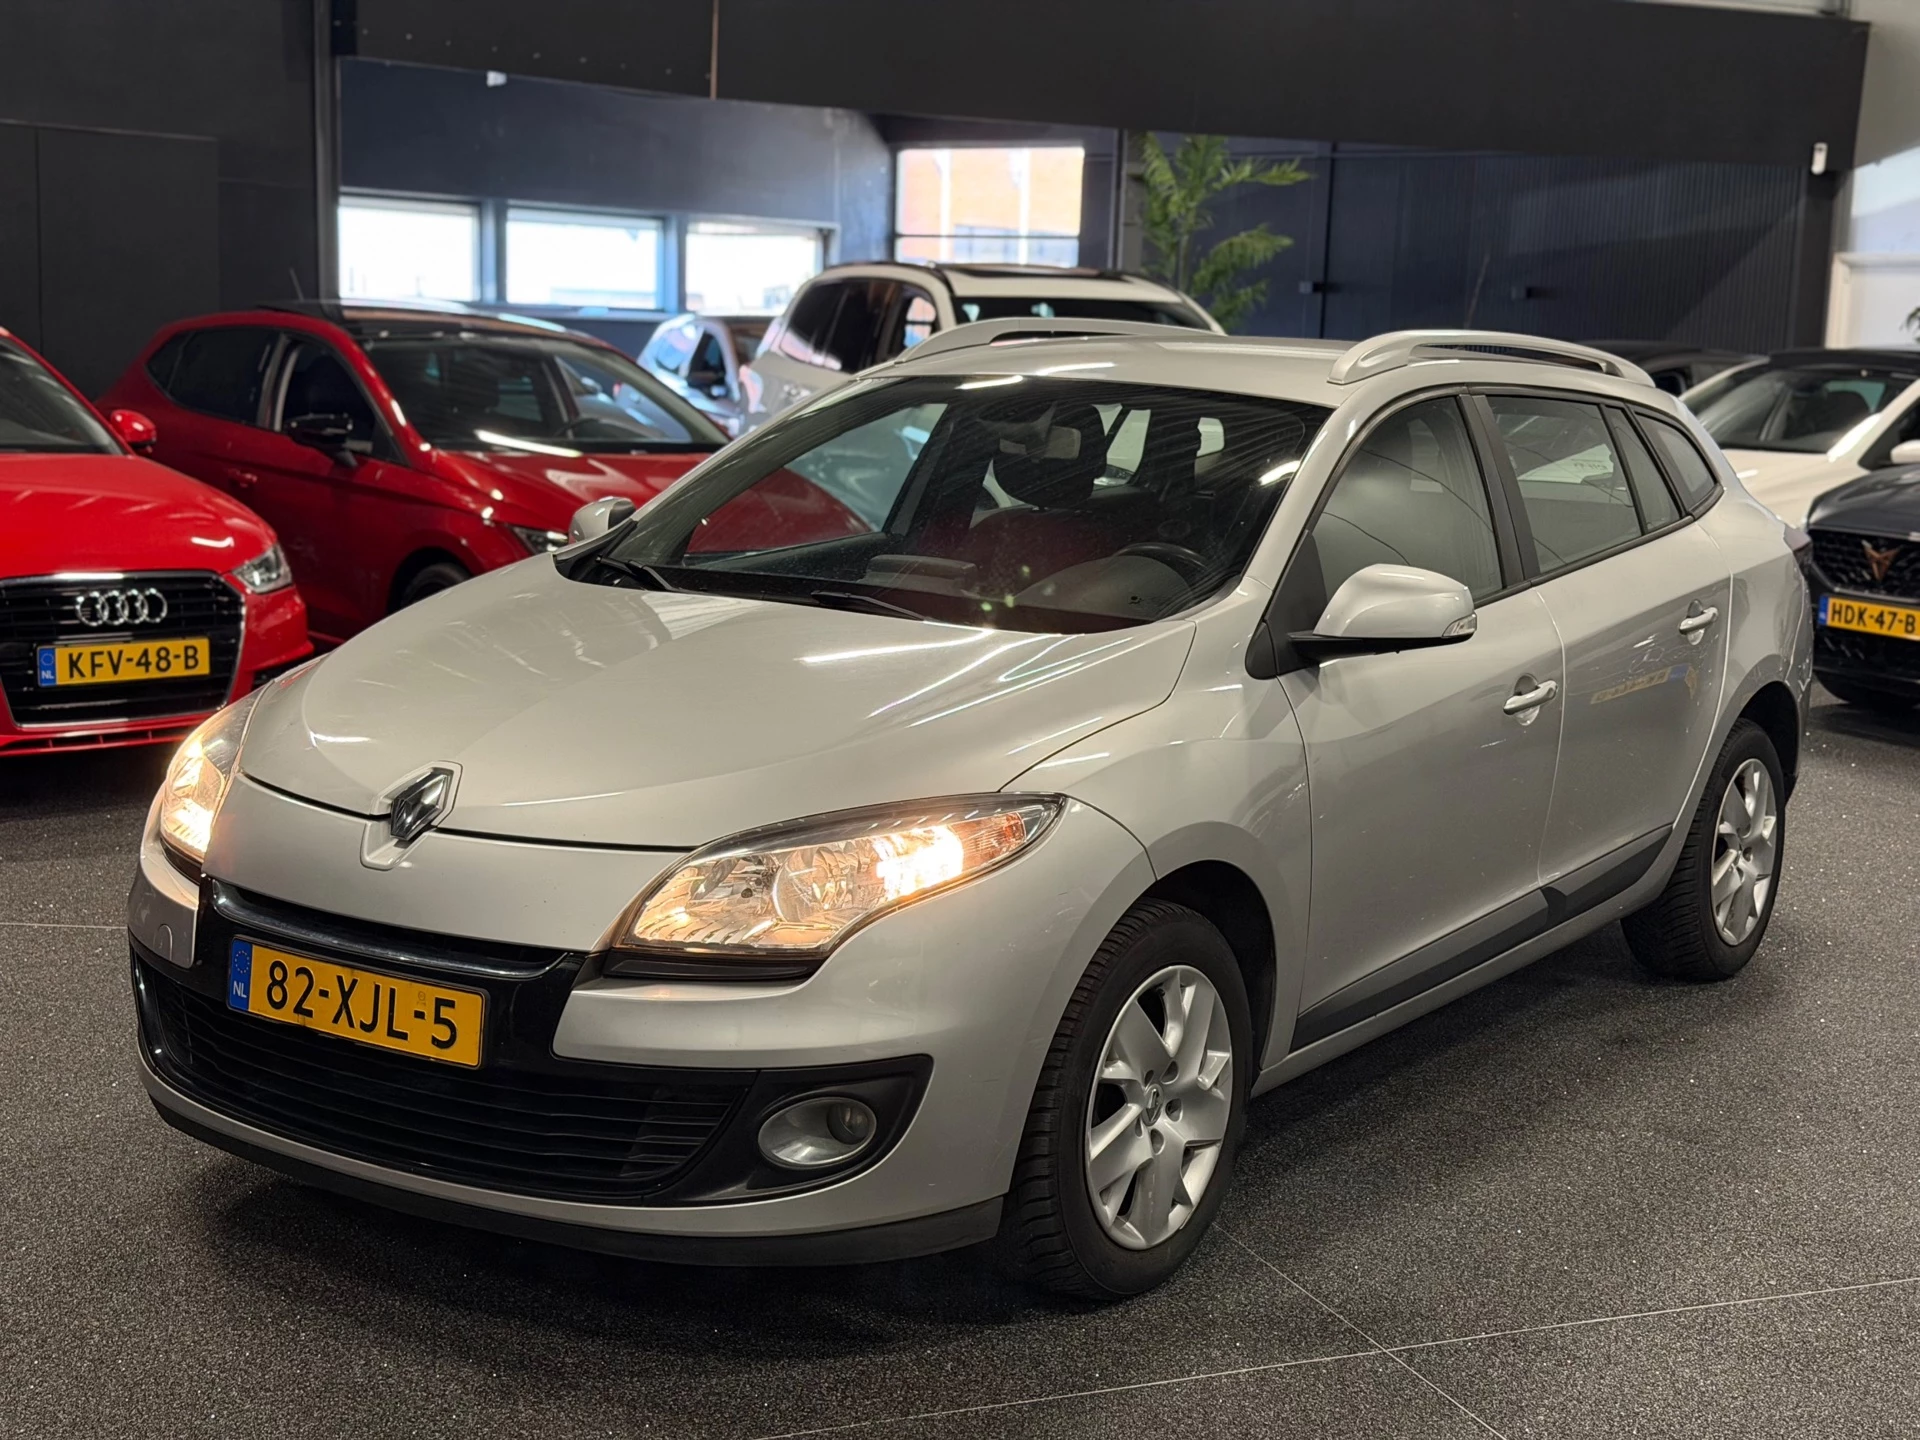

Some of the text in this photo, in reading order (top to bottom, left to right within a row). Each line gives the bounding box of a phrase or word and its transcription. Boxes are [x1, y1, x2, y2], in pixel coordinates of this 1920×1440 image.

[1831, 602, 1916, 634] HDK-47-B
[41, 645, 199, 680] NL KFV-48-B
[233, 960, 458, 1050] NL 82-XJL-5
